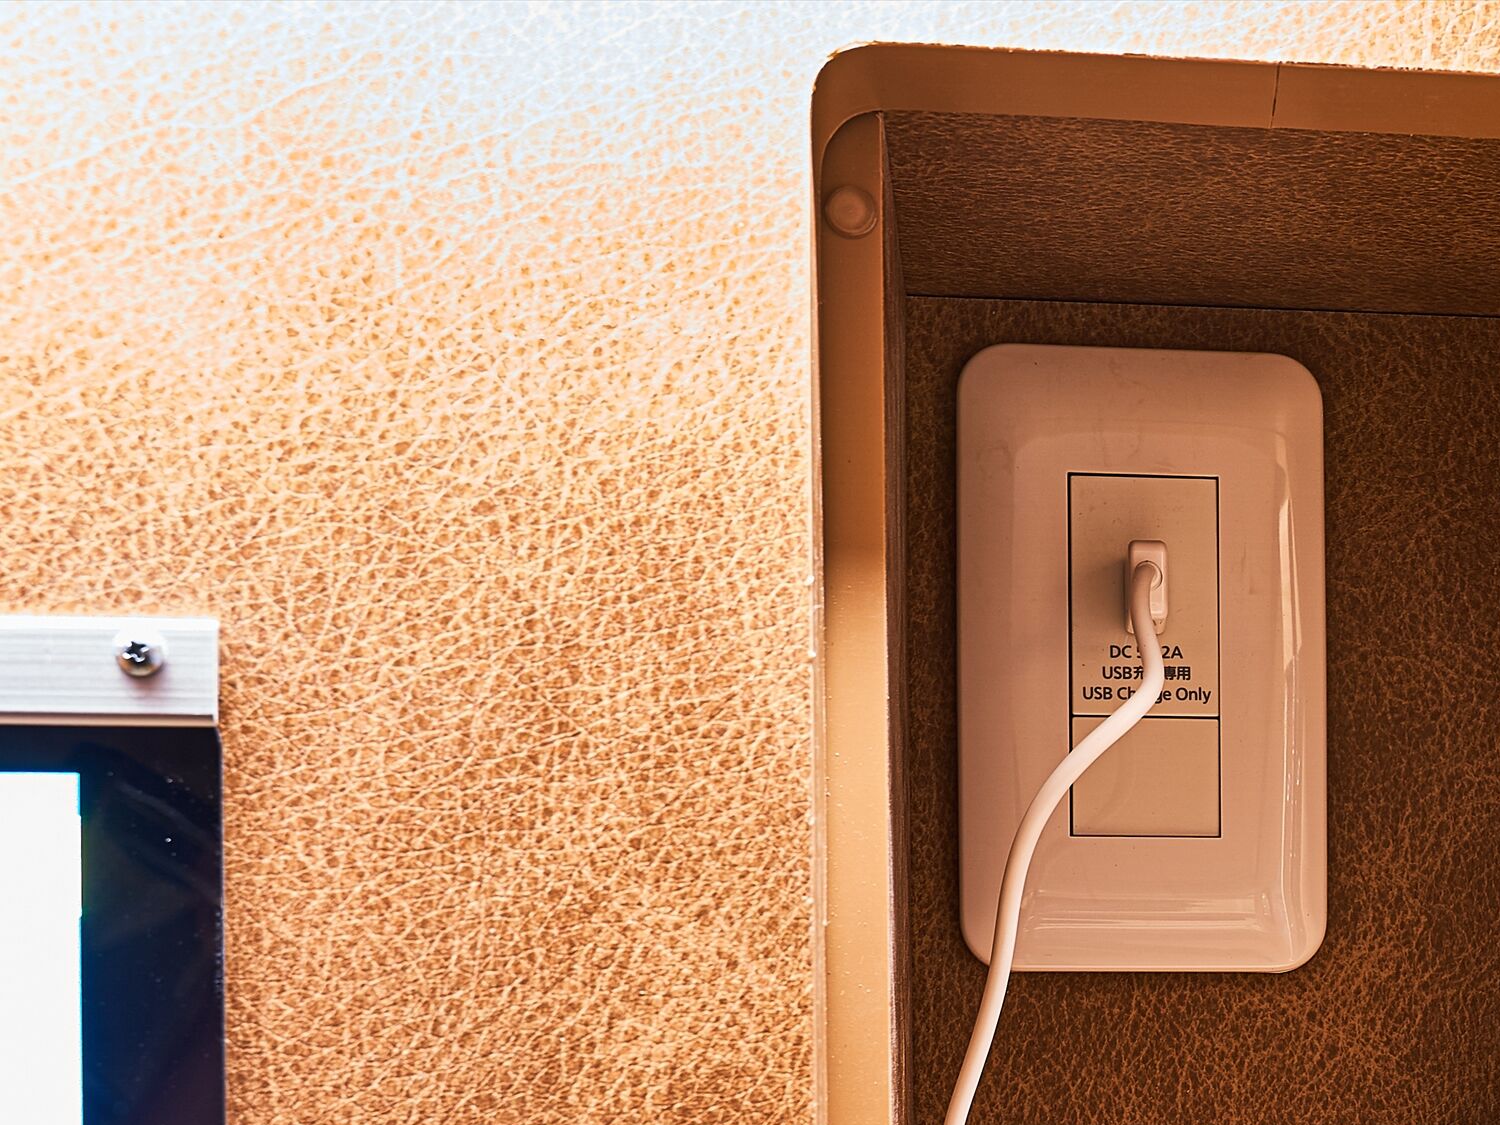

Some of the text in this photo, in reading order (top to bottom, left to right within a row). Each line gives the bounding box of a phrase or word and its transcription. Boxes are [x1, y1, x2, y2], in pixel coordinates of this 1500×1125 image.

[1110, 645, 1131, 659] DC
[1161, 646, 1183, 659] 2A
[1102, 666, 1191, 681] USB充専用
[1082, 686, 1212, 705] USB Chge Only
